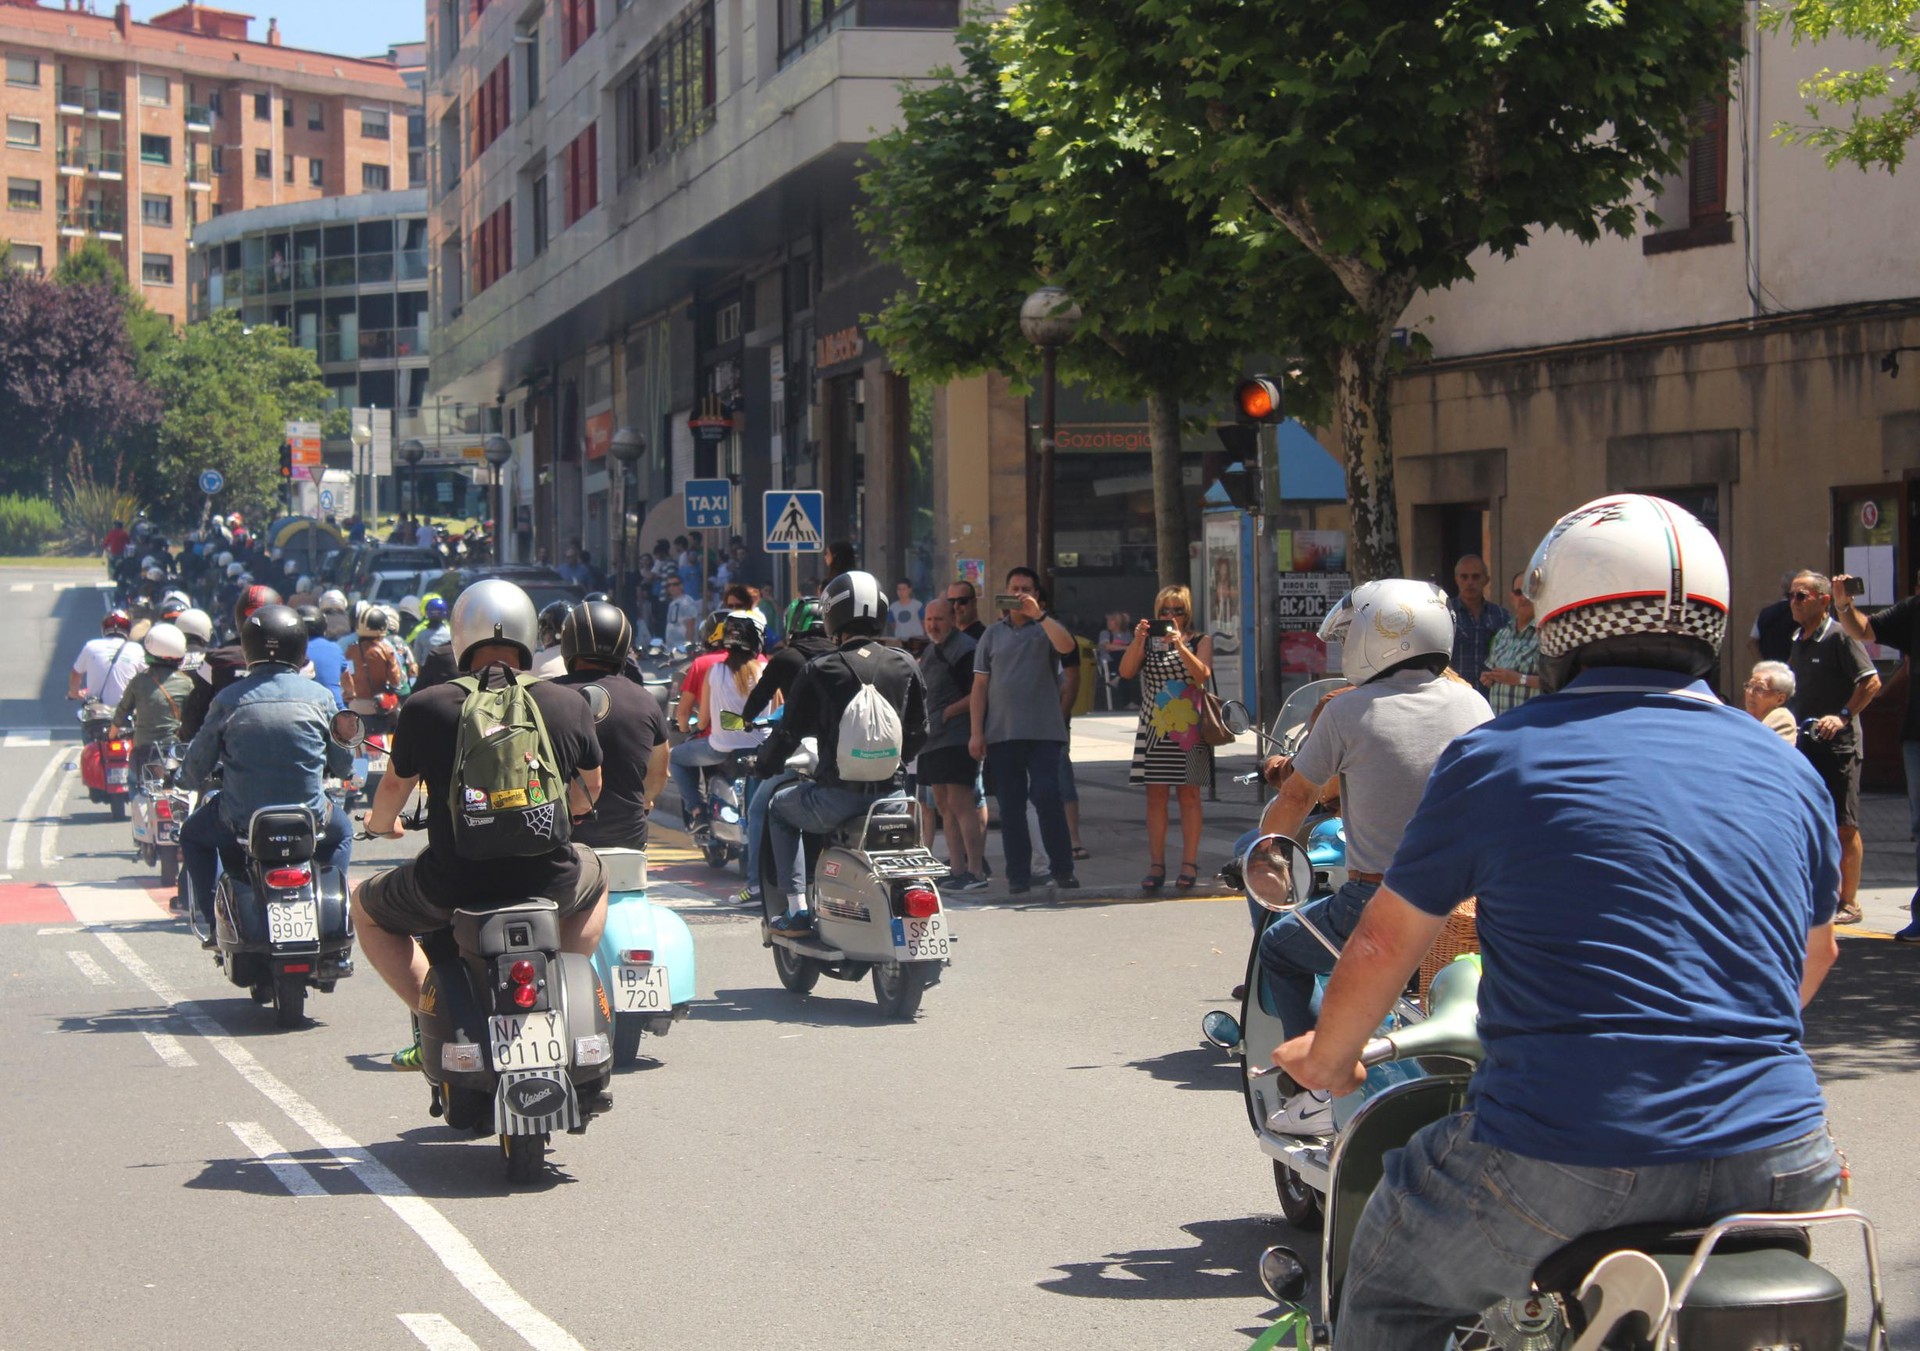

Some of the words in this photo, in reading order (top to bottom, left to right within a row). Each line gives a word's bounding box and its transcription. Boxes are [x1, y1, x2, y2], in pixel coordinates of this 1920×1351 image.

[688, 495, 728, 511] TAXI
[271, 904, 313, 923] SS-L
[272, 922, 313, 939] 9907
[908, 938, 949, 957] 5558
[626, 990, 659, 1008] 720
[497, 1039, 562, 1066] 0110
[518, 1087, 553, 1109] Vespa
